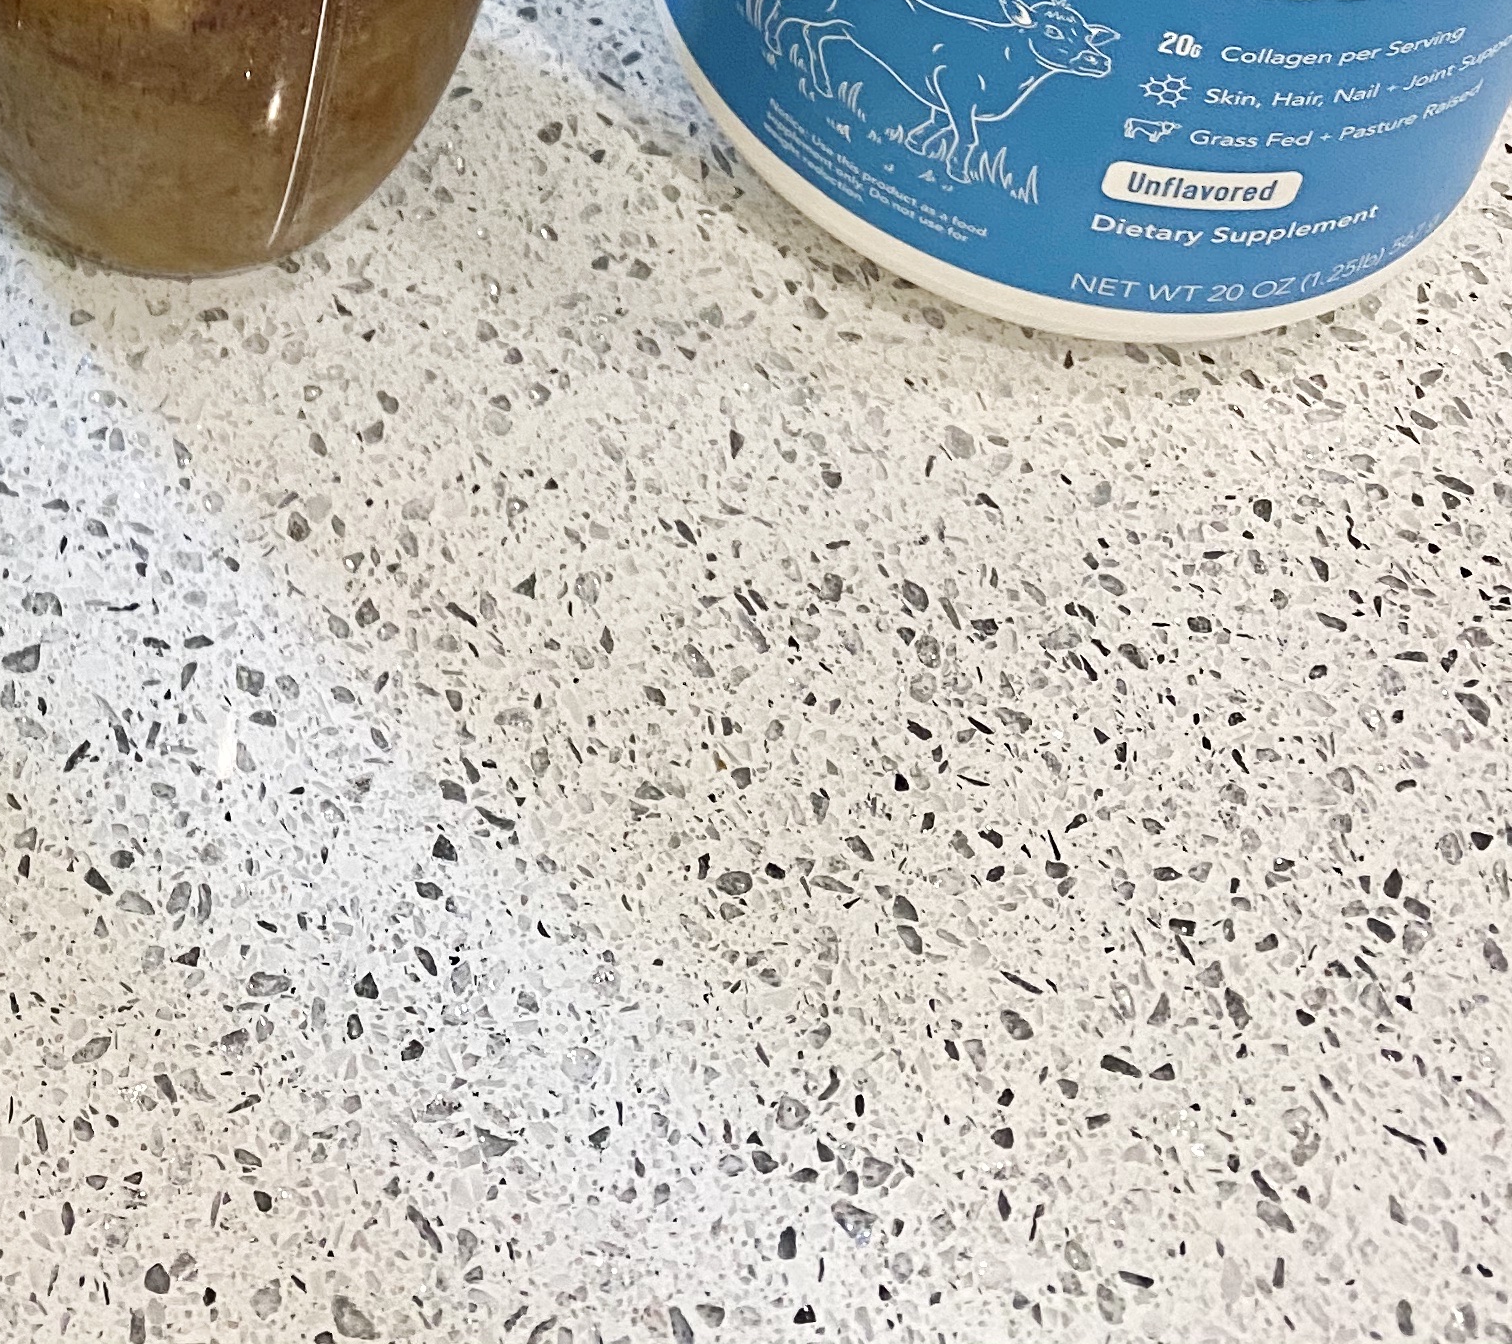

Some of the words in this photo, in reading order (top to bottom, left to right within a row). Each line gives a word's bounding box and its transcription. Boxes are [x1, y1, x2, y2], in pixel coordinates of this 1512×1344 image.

[1221, 45, 1333, 69] Collagen
[1337, 47, 1382, 66] per
[1386, 27, 1467, 57] Serving
[1203, 88, 1262, 110] Skin,
[1271, 91, 1325, 109] Hair,
[1333, 82, 1381, 104] Nail
[1403, 64, 1456, 91] Joint
[1189, 129, 1259, 149] Grass
[1265, 129, 1313, 148] Fed
[1339, 115, 1418, 142] Pasture
[1422, 77, 1484, 120] Raised
[861, 172, 918, 207] product
[1127, 170, 1279, 204] Unflavored
[1090, 213, 1204, 248] Dietary
[1210, 204, 1380, 247] Supplement
[1070, 272, 1141, 300] NET
[1148, 285, 1203, 303] WT
[1205, 284, 1245, 303] 20
[1251, 276, 1296, 299] OZ
